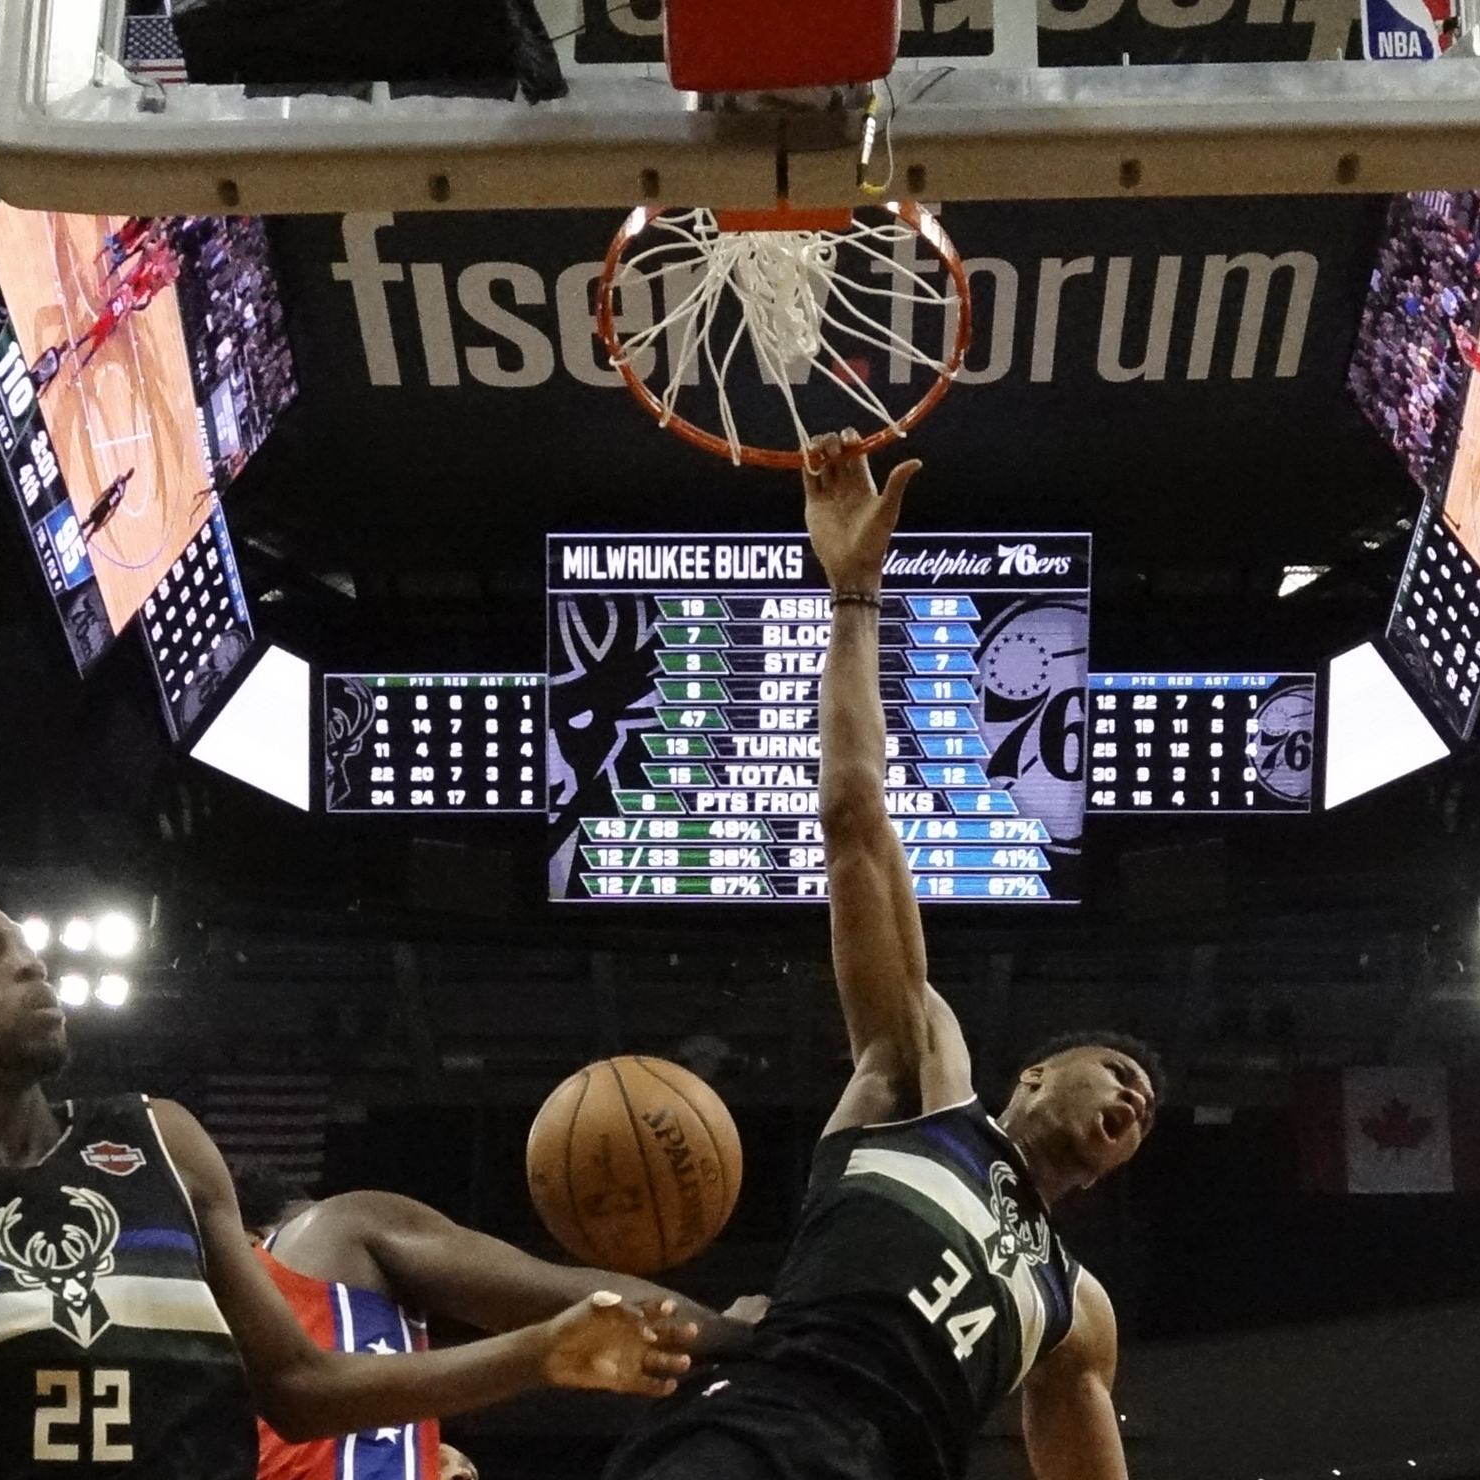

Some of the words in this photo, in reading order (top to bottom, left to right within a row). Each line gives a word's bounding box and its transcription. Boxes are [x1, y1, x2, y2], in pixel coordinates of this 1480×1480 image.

[1377, 30, 1423, 59] NBA
[870, 202, 1320, 385] forum
[31, 430, 58, 488] 3:01
[19, 464, 41, 507] 4th
[56, 515, 85, 574] 95
[563, 545, 710, 579] MILWAUKEE
[715, 545, 803, 579] BUCKS
[882, 549, 992, 584] ladelphia
[997, 544, 1071, 575] 76ers
[681, 599, 705, 617] 19
[761, 599, 833, 619] ASSI
[930, 599, 957, 616] 22
[687, 627, 701, 643] 7
[763, 626, 831, 646] BLOC
[934, 627, 949, 643] 4
[687, 654, 701, 671] 3
[764, 653, 825, 673] STEA
[936, 654, 949, 670] 7
[760, 681, 812, 701] OFF
[933, 682, 951, 698] 11
[680, 711, 706, 728] 47
[759, 709, 812, 729] DEF
[929, 710, 956, 727] 35
[666, 738, 689, 755] 13
[732, 736, 899, 757] TURNOS
[945, 738, 964, 755] 11
[371, 766, 395, 782] 22
[410, 766, 434, 782] 20
[668, 767, 691, 784] 15
[725, 765, 812, 786] TOTAL
[942, 767, 966, 784] 12
[371, 790, 395, 806] 34
[410, 790, 434, 805] 34
[447, 790, 466, 805] 17
[696, 793, 748, 812] PTS
[884, 793, 934, 812] NKS
[976, 795, 991, 811] 2
[1091, 790, 1116, 806] 42
[1132, 790, 1153, 806] 15
[595, 820, 626, 838] 43
[989, 821, 1040, 841] 37%
[598, 849, 623, 867] 12
[789, 849, 825, 867] 3P
[928, 850, 955, 867] 41
[992, 850, 1039, 868] 41%
[598, 877, 623, 894] 12
[651, 877, 677, 894] 18
[710, 877, 761, 897] 67%
[928, 878, 954, 895] 12
[988, 877, 1039, 897] 67%
[908, 1249, 997, 1362] 34
[33, 1368, 134, 1462] 22
